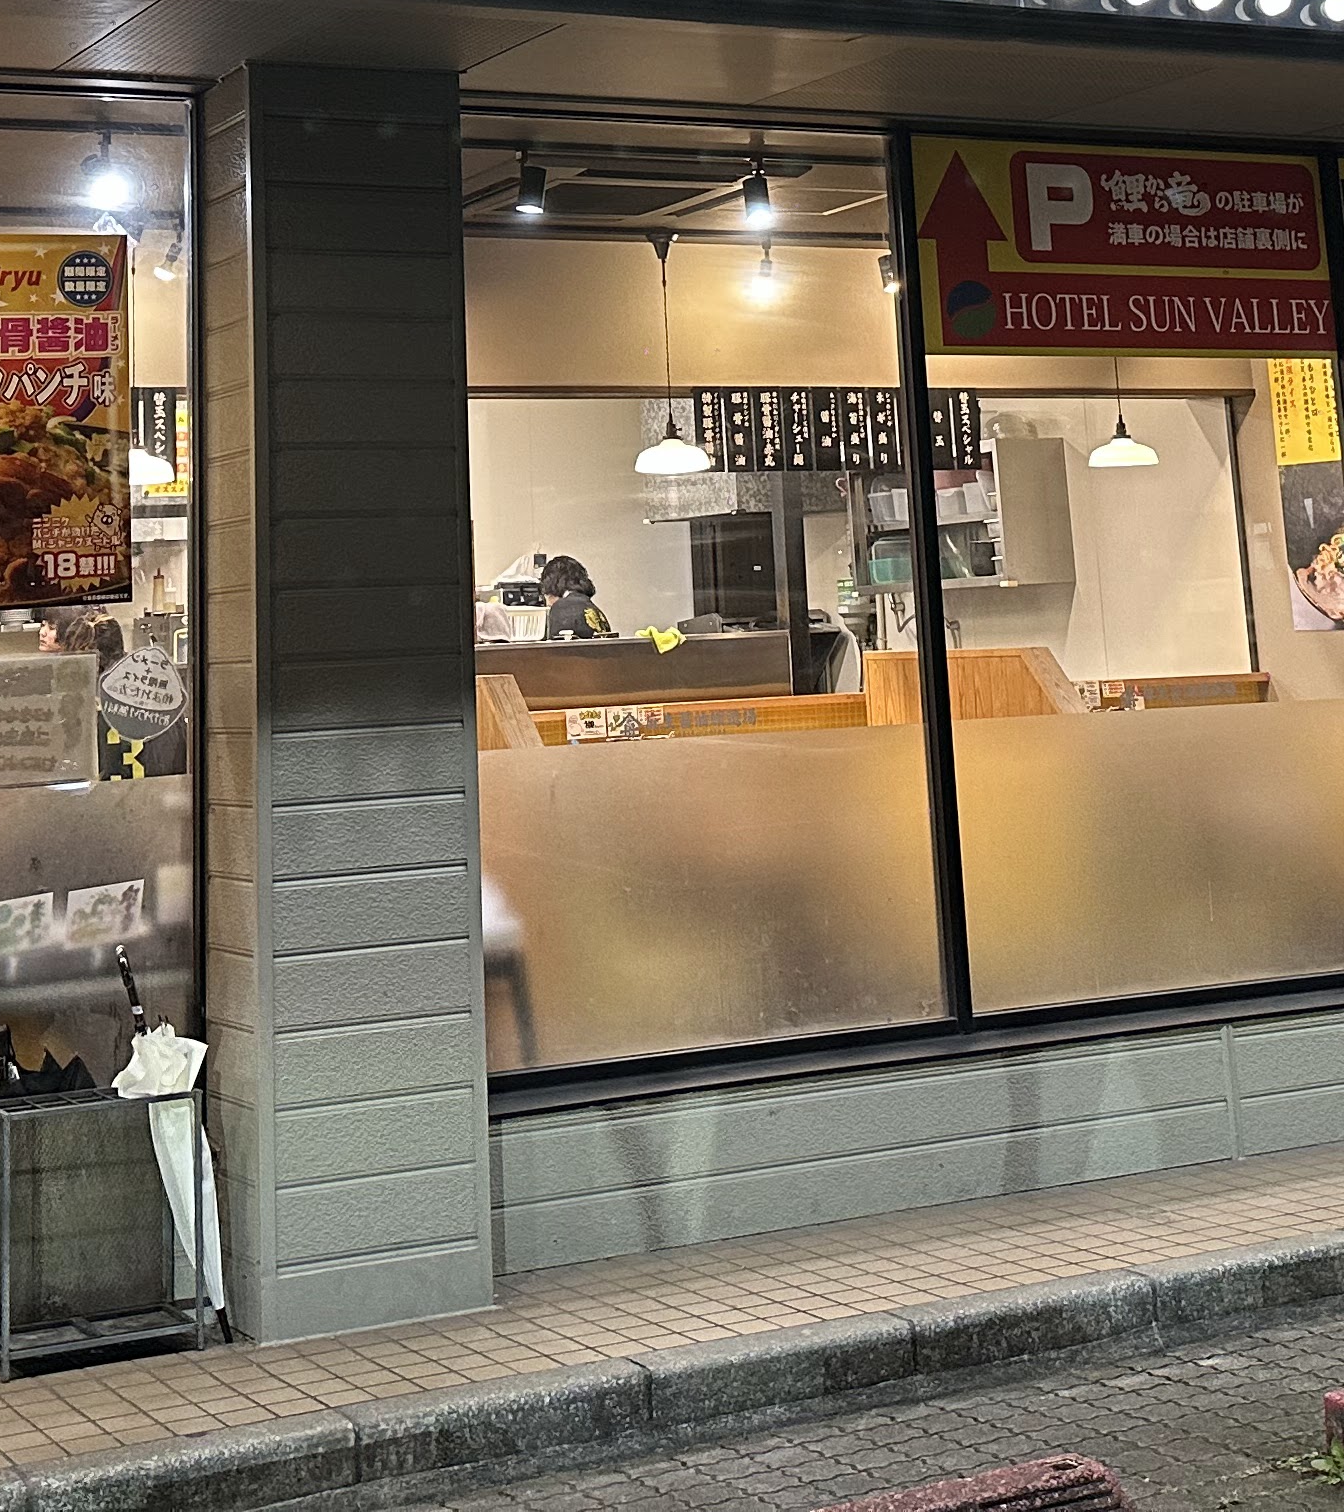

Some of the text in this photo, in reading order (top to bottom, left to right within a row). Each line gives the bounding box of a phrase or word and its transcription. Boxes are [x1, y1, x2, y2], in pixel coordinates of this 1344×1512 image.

[1025, 162, 1094, 251] P
[1107, 221, 1309, 252] 満車の場合は店舗裏側に
[1003, 292, 1332, 336] HOTEL SUN VALLEY
